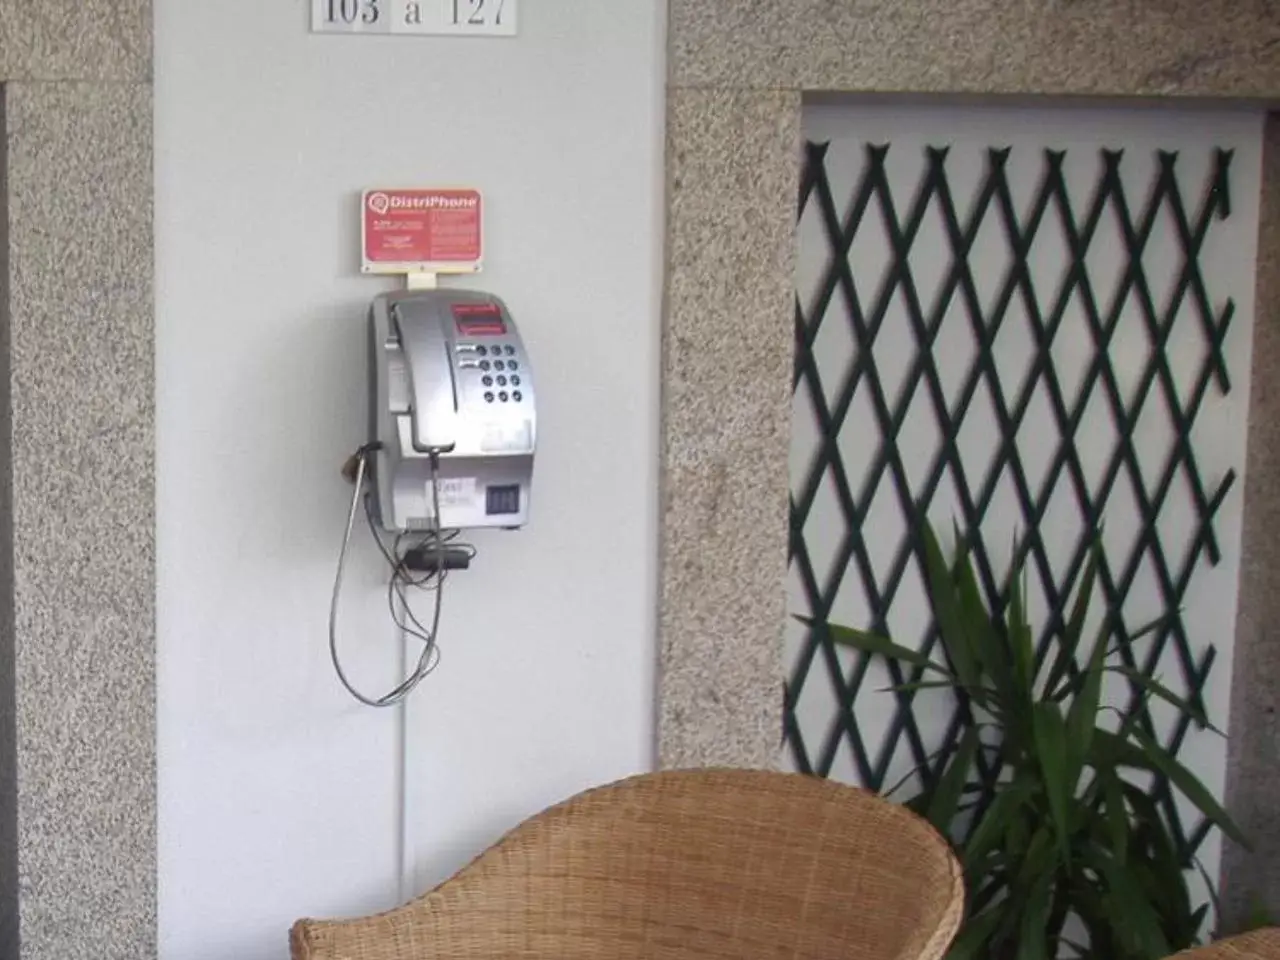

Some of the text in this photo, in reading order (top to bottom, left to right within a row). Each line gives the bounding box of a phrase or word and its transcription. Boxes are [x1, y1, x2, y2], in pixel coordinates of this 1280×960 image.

[325, 0, 506, 24] 103 a 127
[391, 195, 477, 209] DistriPhone
